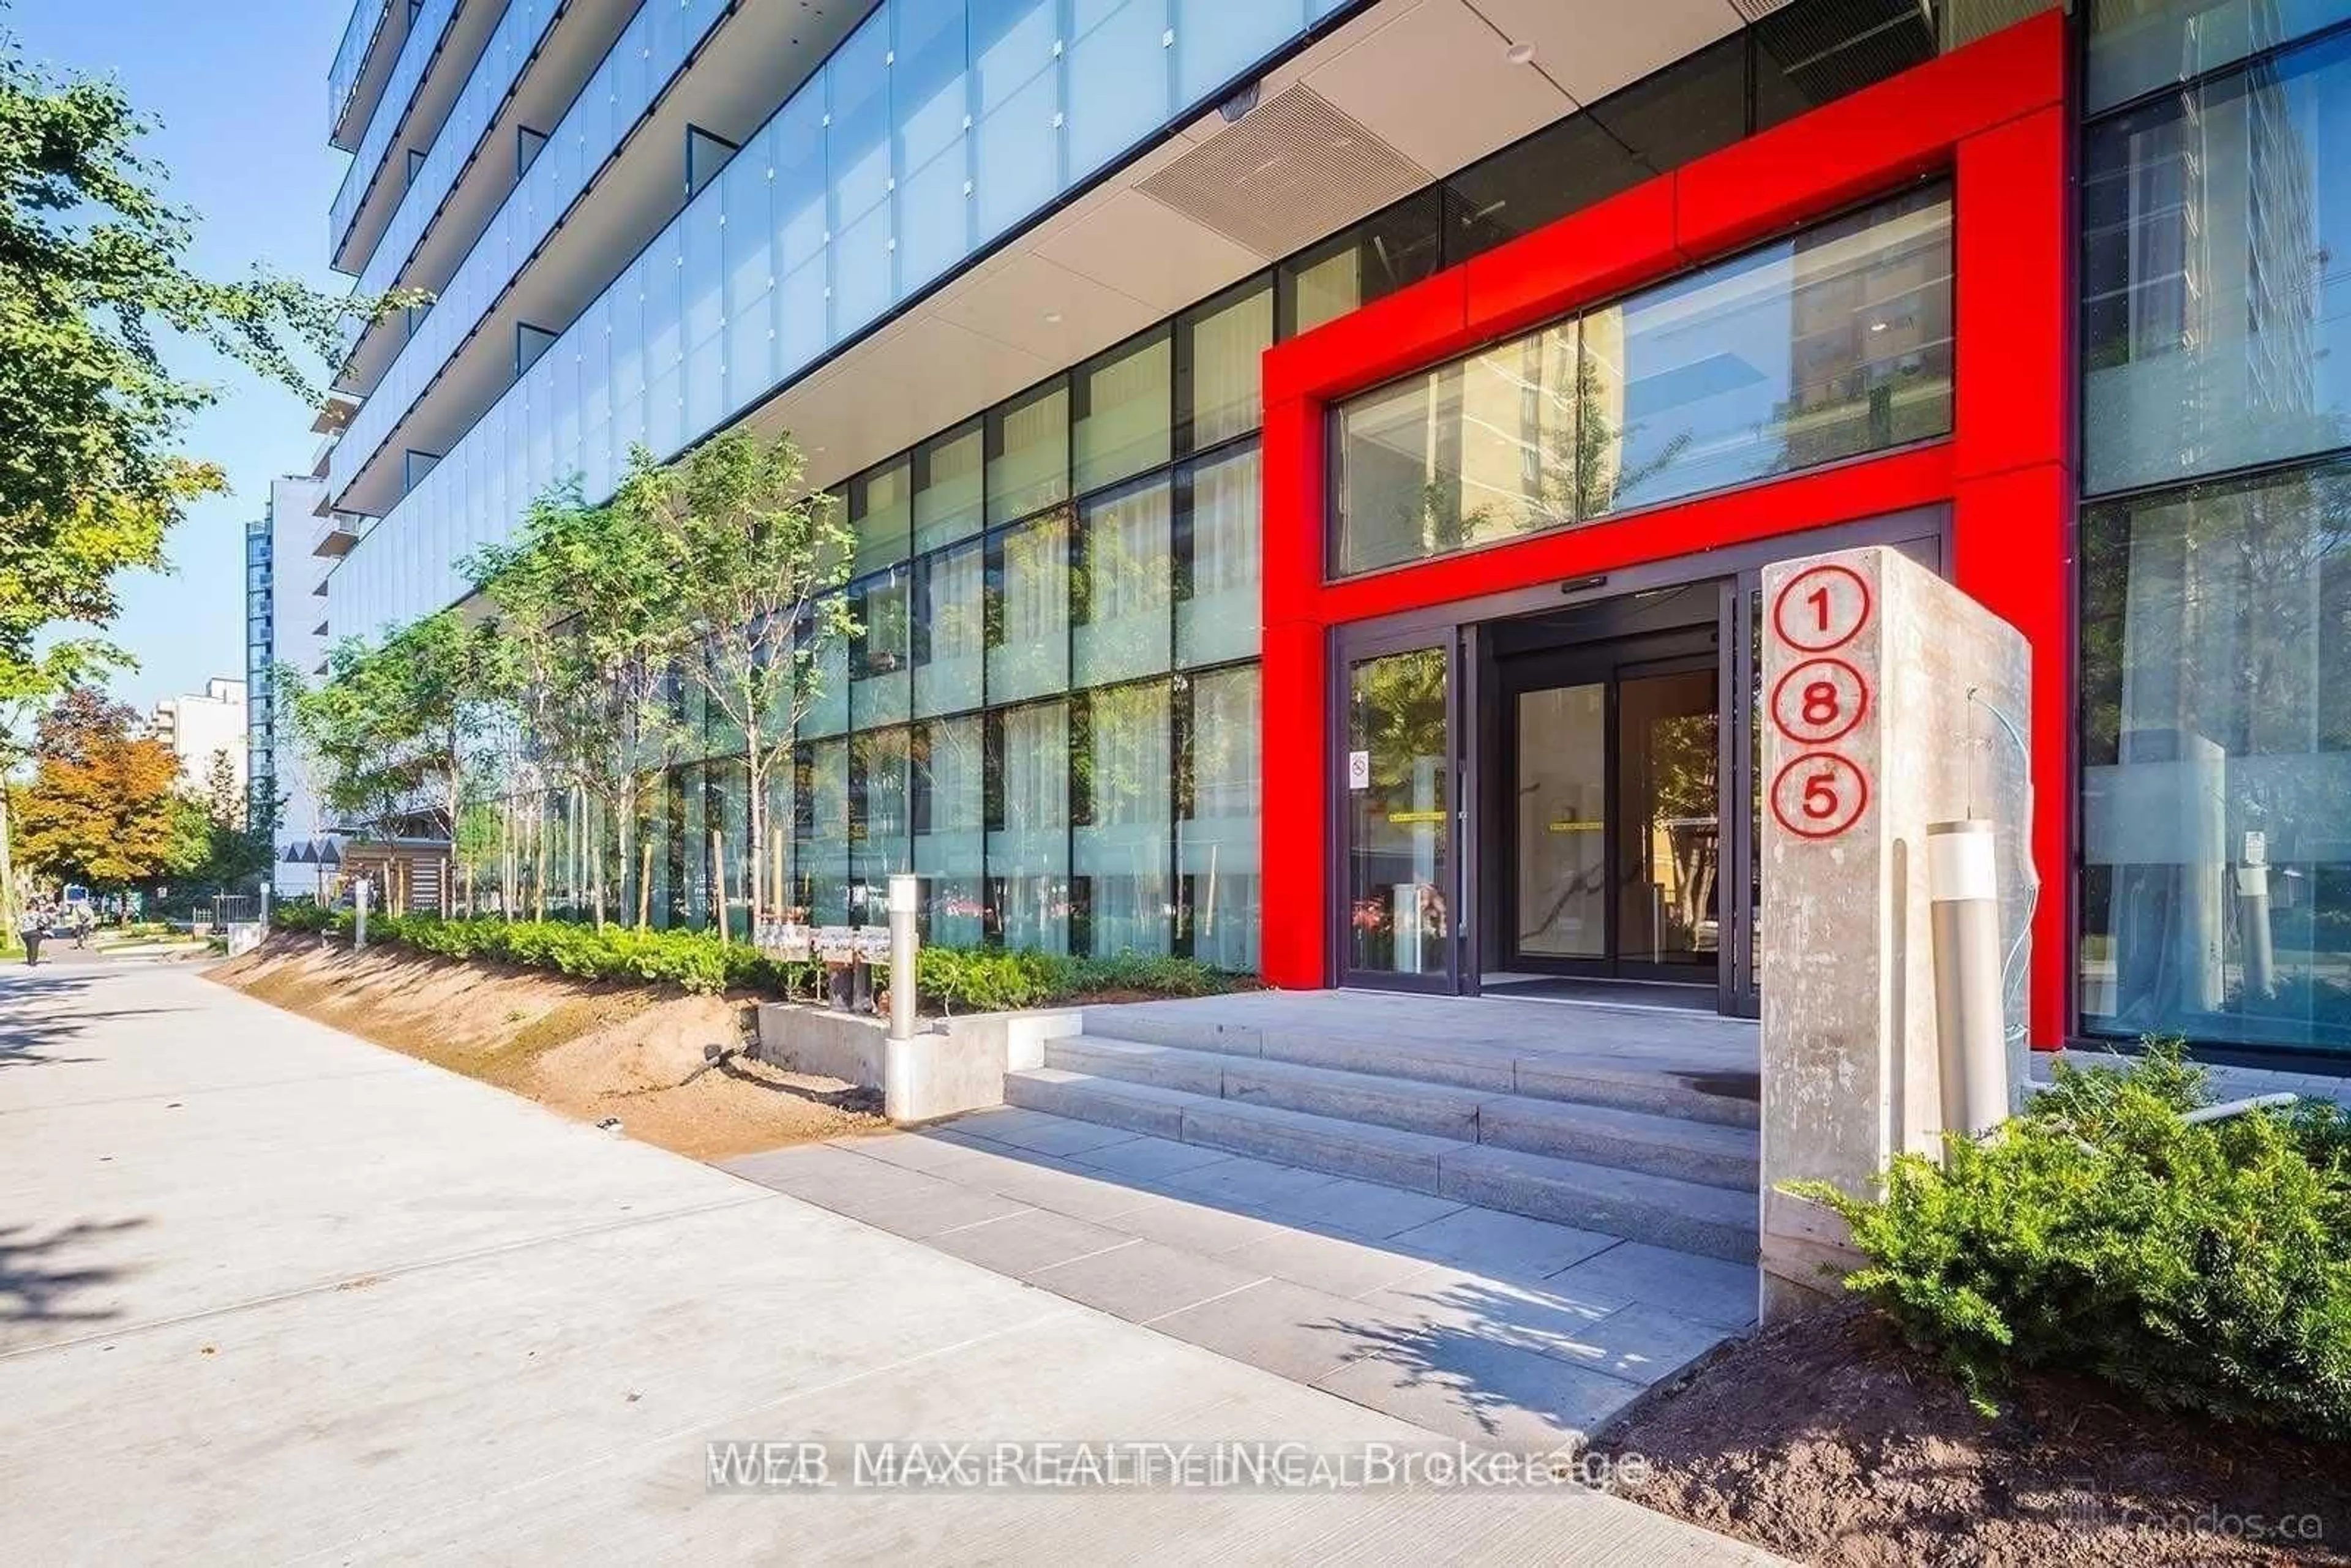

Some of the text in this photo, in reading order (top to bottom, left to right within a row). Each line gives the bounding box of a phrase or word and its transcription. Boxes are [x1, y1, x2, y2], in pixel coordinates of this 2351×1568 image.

[1807, 586, 1829, 631] 1
[1802, 681, 1839, 726] 8
[1802, 773, 1838, 819] 5
